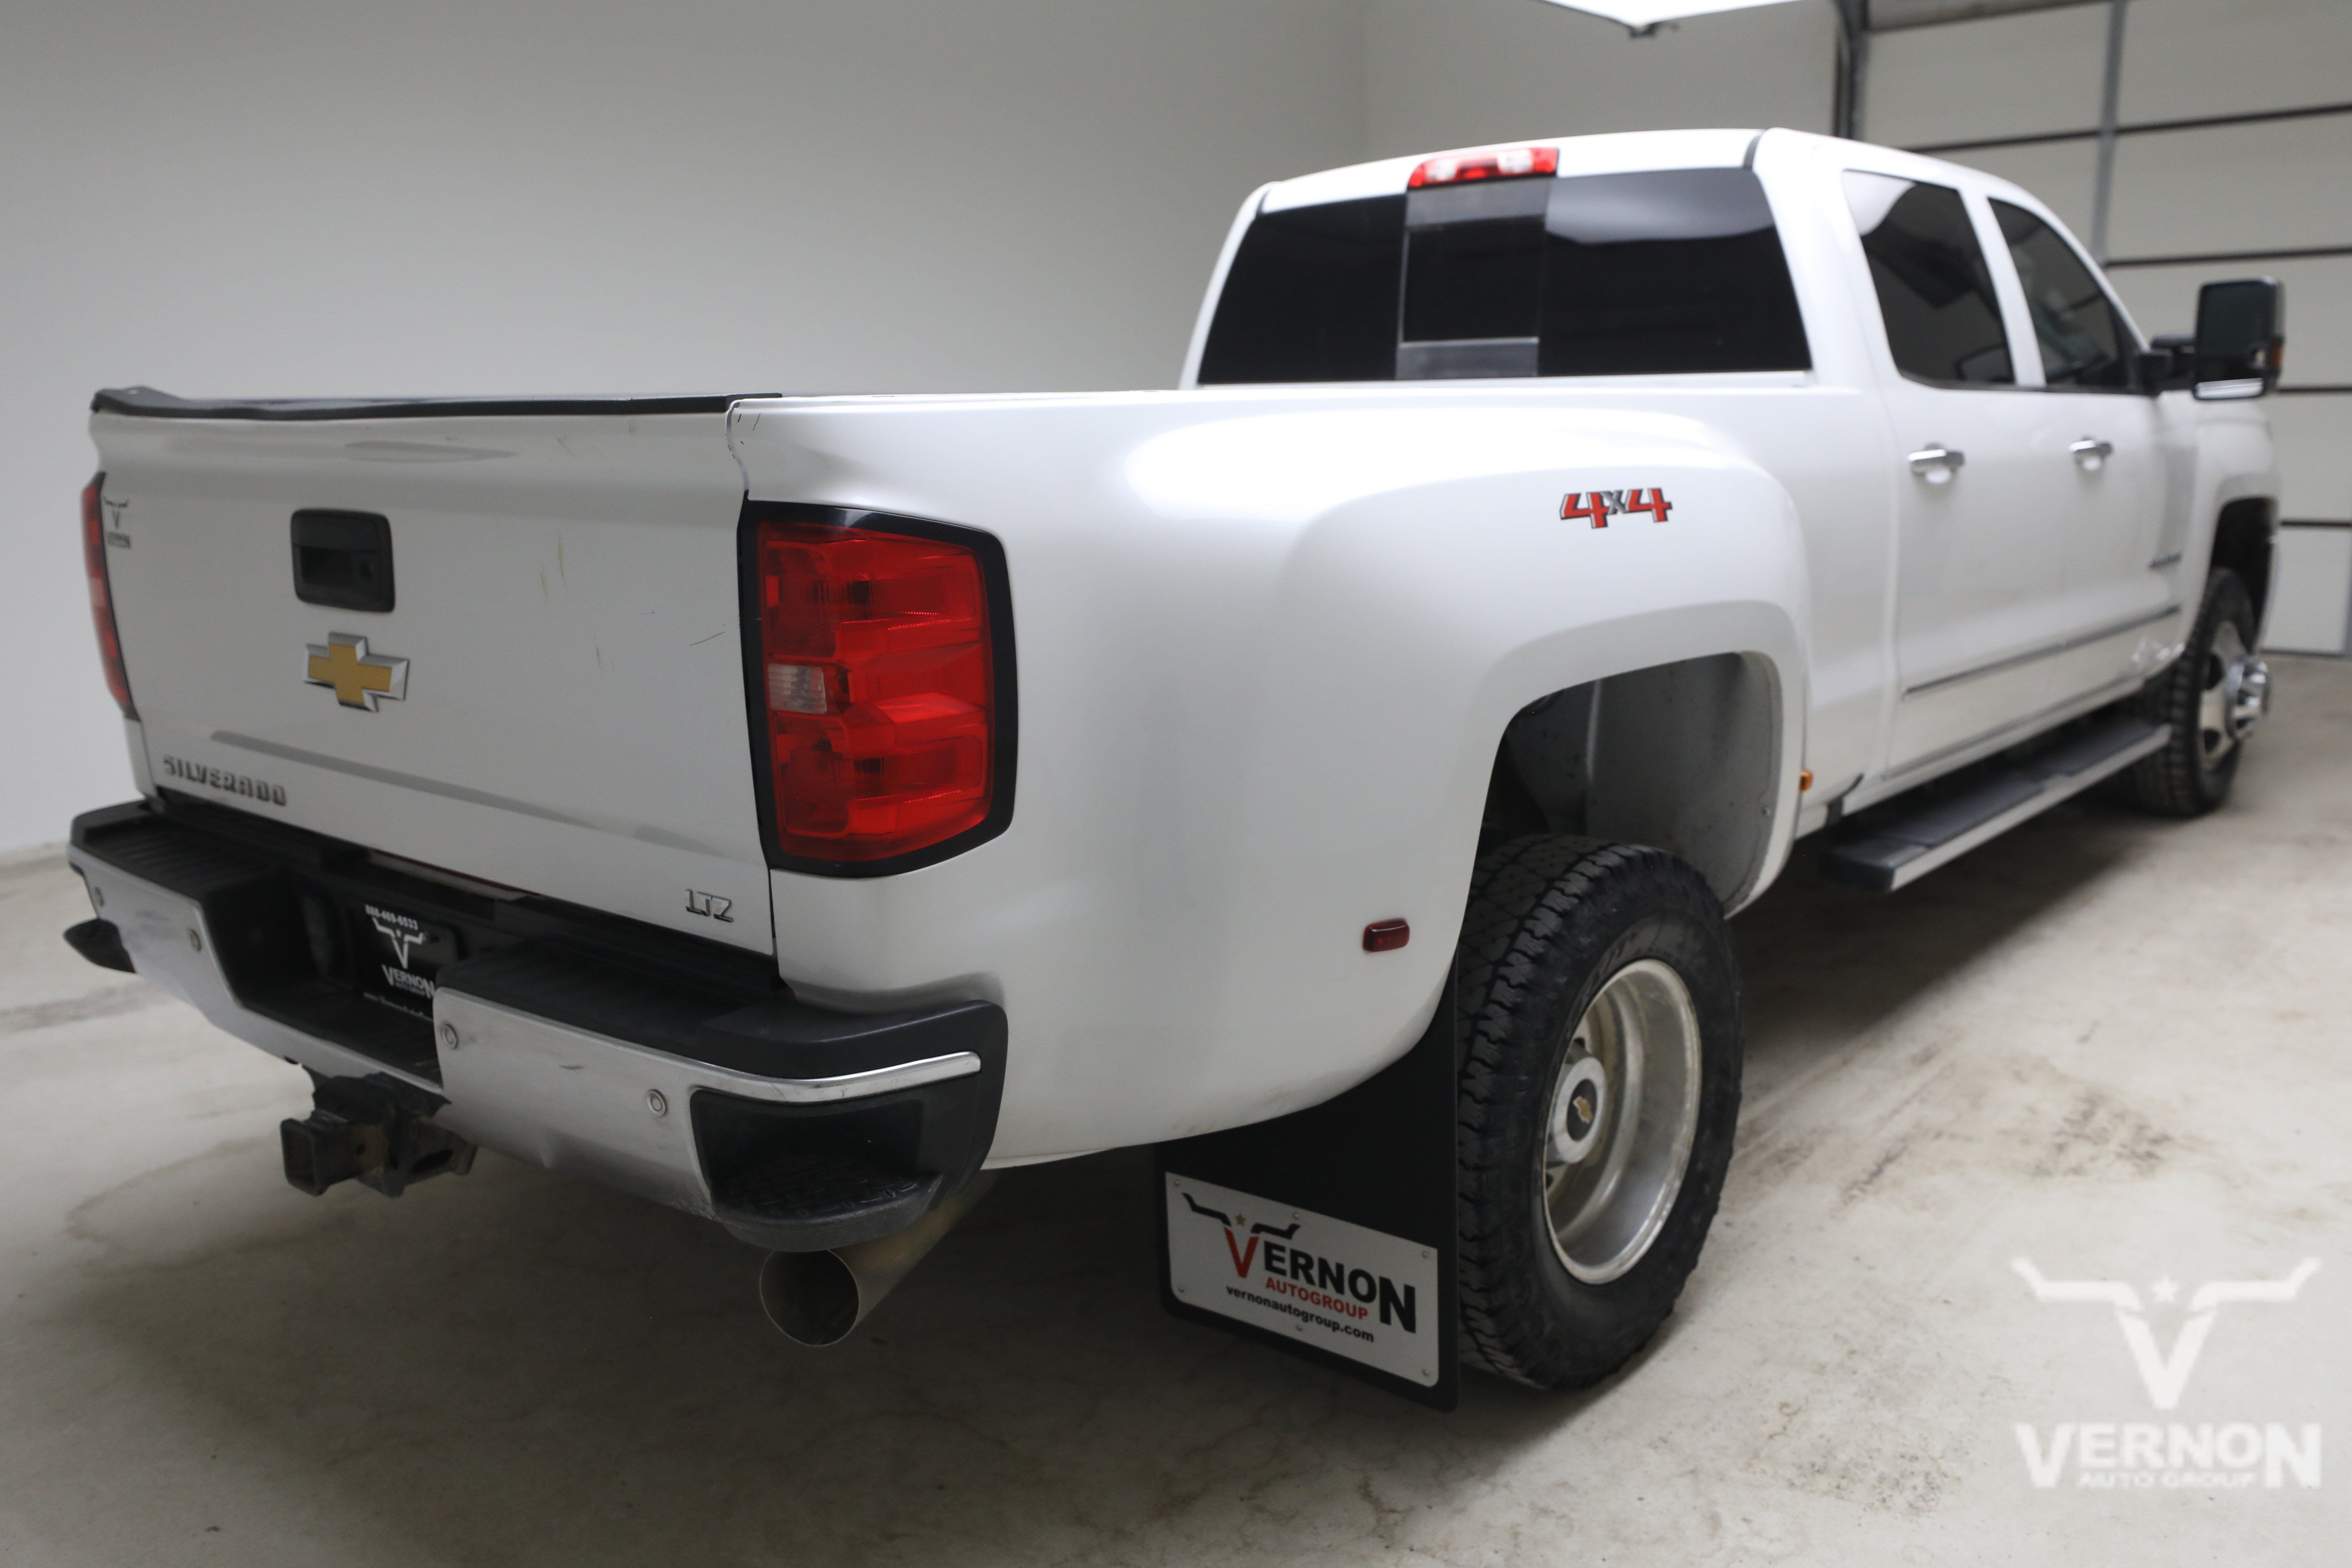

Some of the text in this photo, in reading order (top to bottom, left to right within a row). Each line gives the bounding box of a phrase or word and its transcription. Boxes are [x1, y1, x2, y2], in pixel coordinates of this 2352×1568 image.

[164, 754, 287, 806] SILVERADO
[685, 888, 733, 922] LTZ
[381, 964, 434, 999] VERNON
[1224, 1226, 1417, 1334] VERNON
[1266, 1276, 1368, 1320] AUTOGROUP
[1226, 1285, 1374, 1342] vernonautogroup.com
